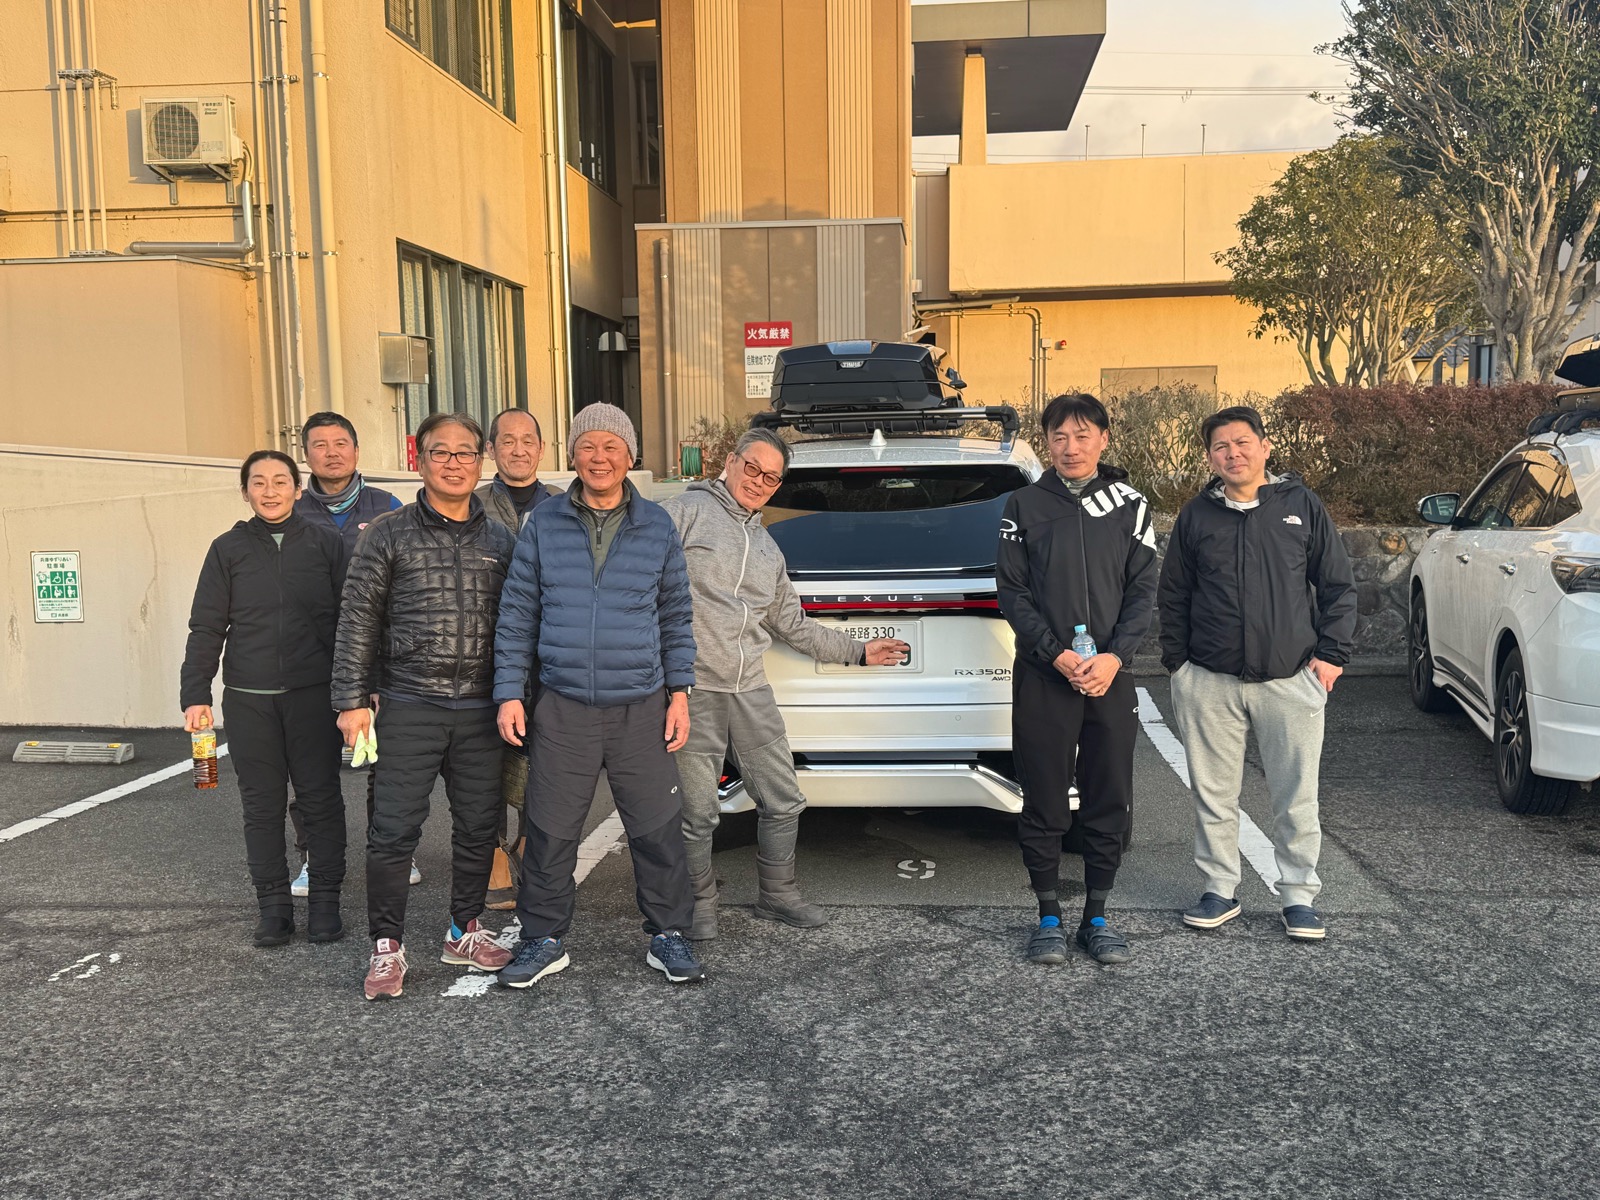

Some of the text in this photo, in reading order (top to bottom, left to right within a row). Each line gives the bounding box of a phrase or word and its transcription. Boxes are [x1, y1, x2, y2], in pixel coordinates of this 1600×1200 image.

[747, 328, 790, 340] 火気厳禁
[998, 531, 1023, 544] LEY
[872, 627, 895, 639] 330
